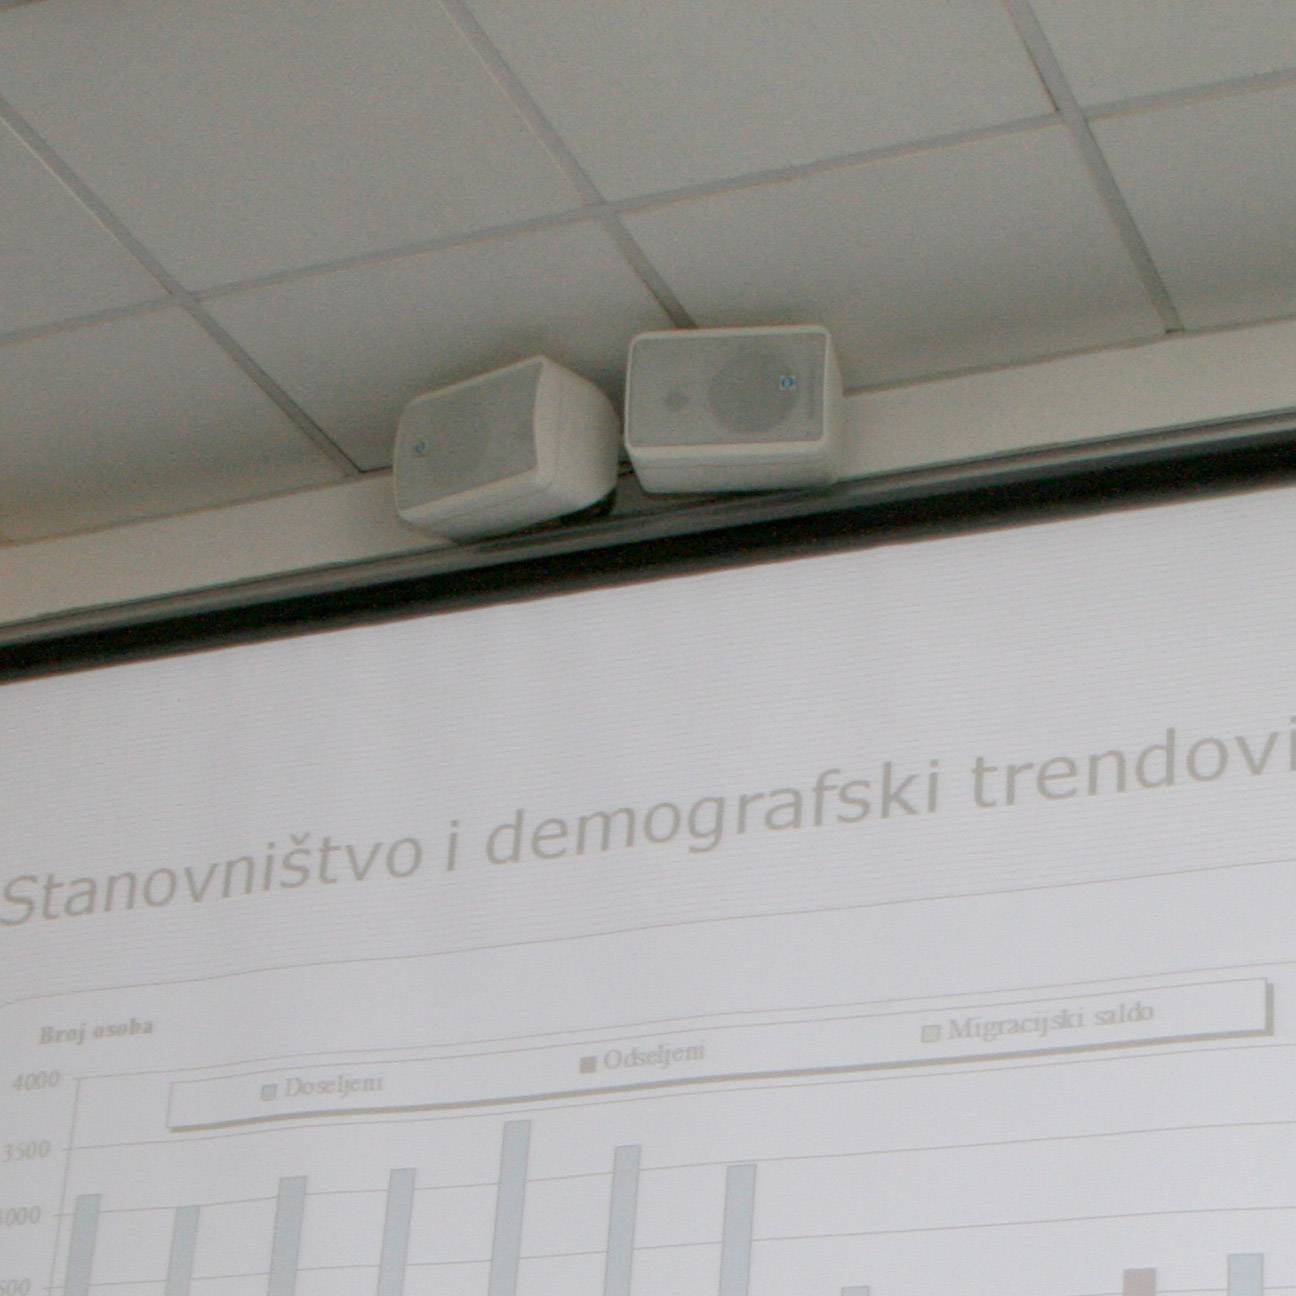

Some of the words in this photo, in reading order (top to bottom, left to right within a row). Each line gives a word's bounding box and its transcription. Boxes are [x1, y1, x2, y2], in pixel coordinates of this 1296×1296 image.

[0, 832, 424, 927] Stanovništvo
[445, 820, 461, 873] i
[485, 759, 941, 866] demografski
[38, 1022, 87, 1046] Broj
[93, 1016, 154, 1039] osoba
[948, 1005, 1085, 1042] Migracijski
[1094, 1001, 1155, 1025] saldo
[604, 1040, 706, 1070] Odseljeni
[13, 1069, 61, 1091] 4000
[285, 1073, 384, 1098] Doseljeni
[3, 1139, 51, 1162] 3500
